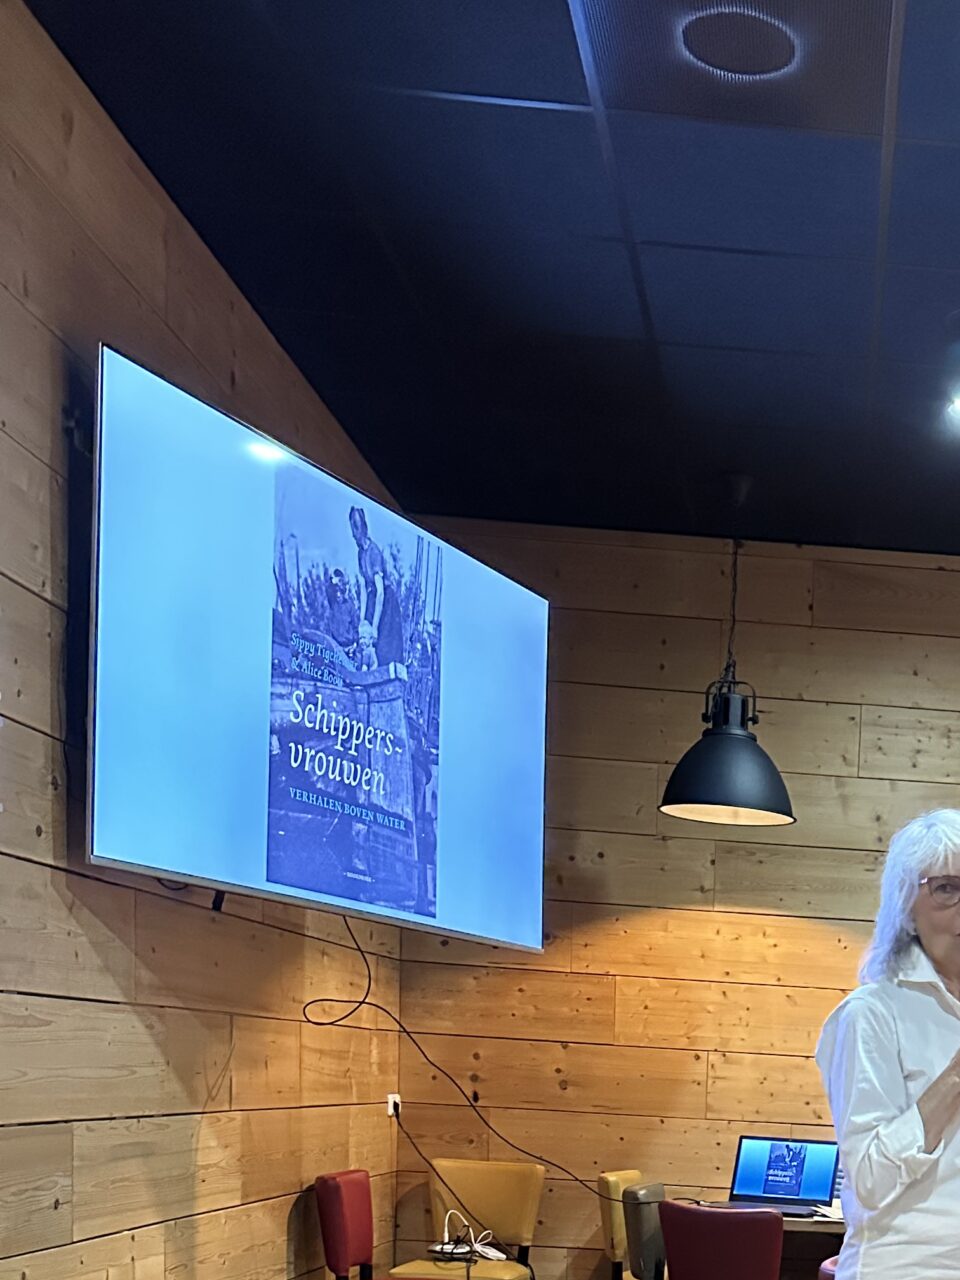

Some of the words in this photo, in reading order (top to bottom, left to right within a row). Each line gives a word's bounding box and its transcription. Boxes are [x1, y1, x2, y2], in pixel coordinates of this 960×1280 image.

[291, 633, 315, 657] Sippy
[291, 656, 300, 672] &
[301, 660, 322, 679] Alice
[289, 690, 403, 757] Schippers-
[288, 742, 385, 795] vrouwen
[289, 787, 342, 812] VERHALEN
[344, 803, 374, 821] BOVEN
[376, 812, 406, 831] WATER
